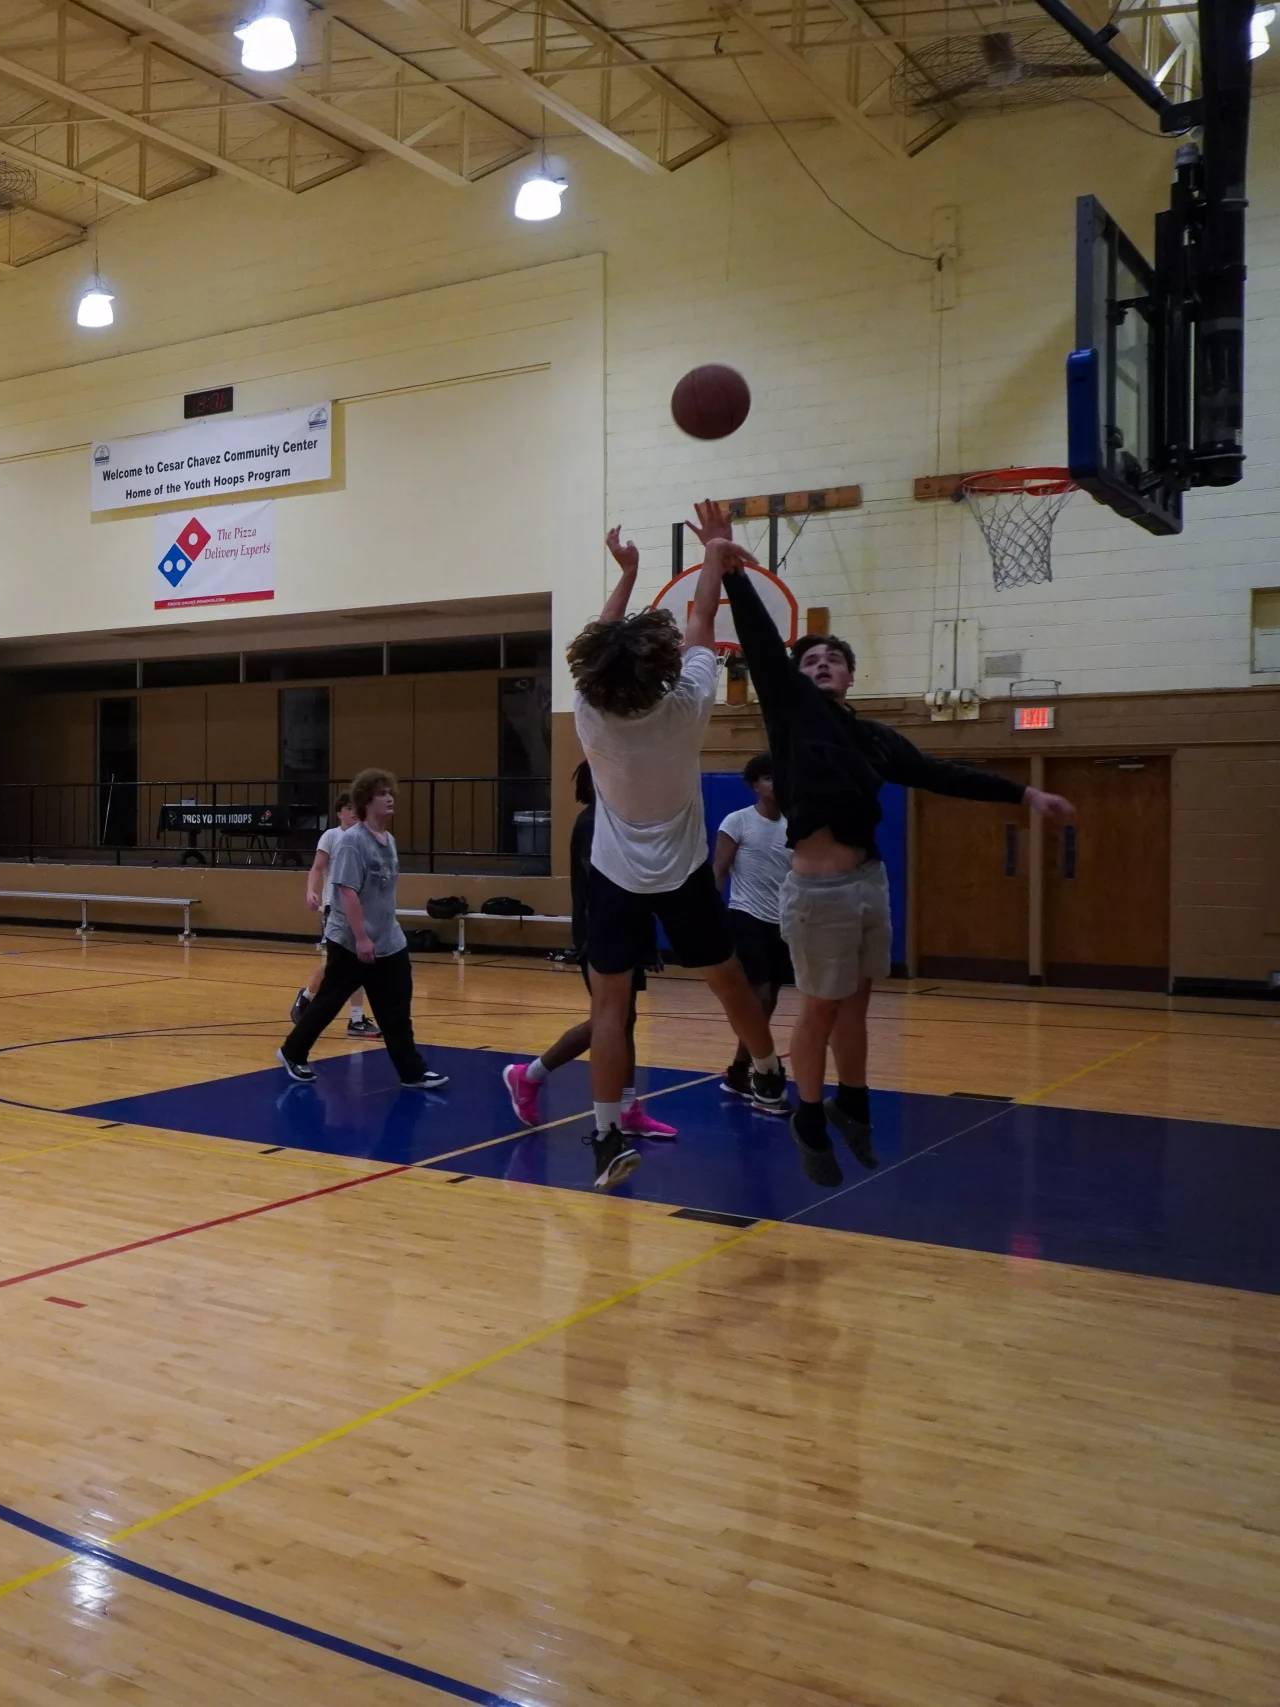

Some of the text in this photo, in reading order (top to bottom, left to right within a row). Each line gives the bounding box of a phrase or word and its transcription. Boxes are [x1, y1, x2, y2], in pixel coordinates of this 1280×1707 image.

[102, 438, 318, 482] Welcome to Cesar Chavez Community Center
[125, 467, 291, 500] Home of the Youth Hoops Program
[217, 526, 257, 541] The Pizza
[204, 542, 270, 561] Delivery Experts
[1021, 707, 1049, 728] EXIT
